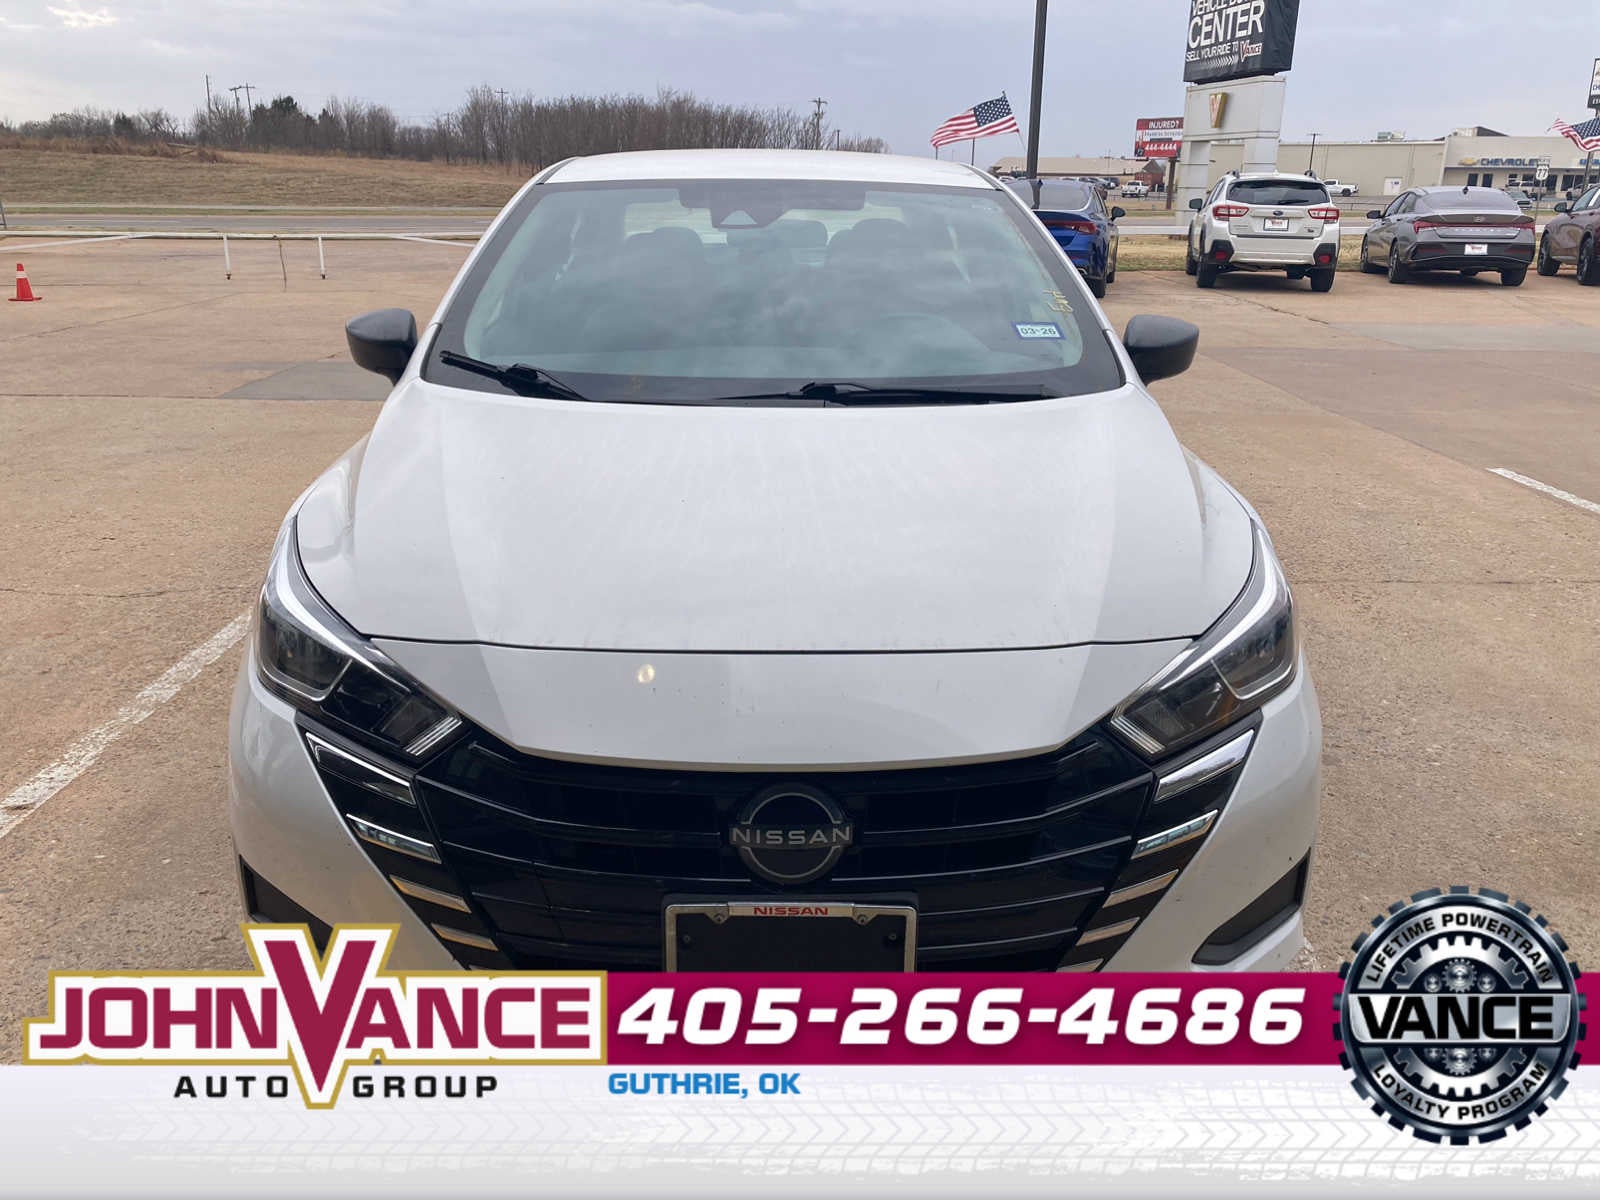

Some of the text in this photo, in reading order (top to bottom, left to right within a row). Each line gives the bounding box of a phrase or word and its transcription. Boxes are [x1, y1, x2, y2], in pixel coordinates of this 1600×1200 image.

[1188, 1, 1264, 48] CENTER
[1186, 50, 1200, 62] SELL
[1201, 46, 1217, 58] YOUR
[1217, 42, 1231, 55] RIDE
[1149, 120, 1180, 129] INJURED?
[1144, 143, 1177, 152] 444-4444
[1537, 168, 1548, 178] 77
[732, 825, 851, 846] NISSAN
[753, 906, 829, 916] NISSAN
